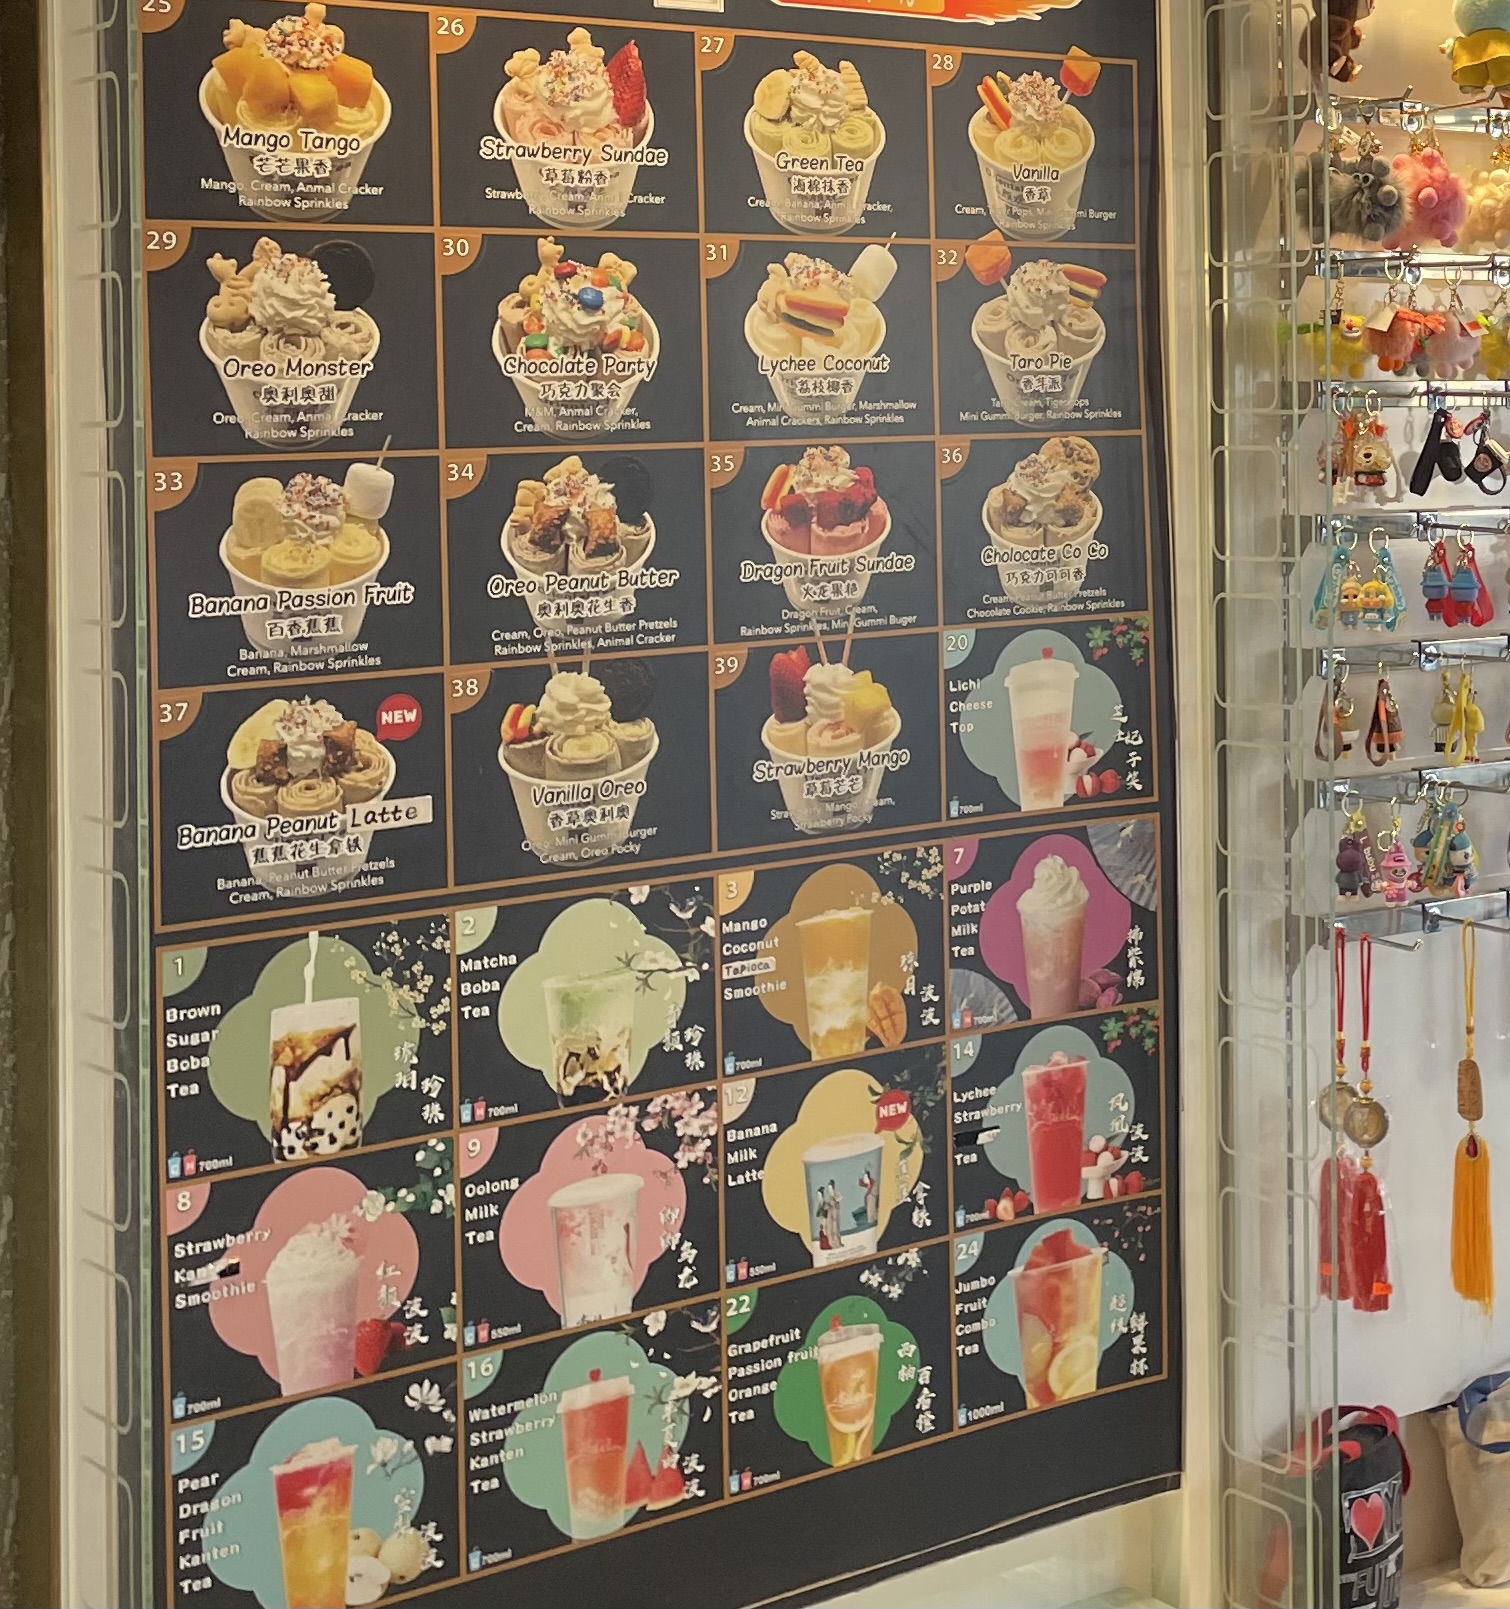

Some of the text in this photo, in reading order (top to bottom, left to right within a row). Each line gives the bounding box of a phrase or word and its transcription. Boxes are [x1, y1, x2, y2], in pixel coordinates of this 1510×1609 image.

[436, 17, 464, 36] 26
[701, 37, 724, 53] 27
[932, 54, 954, 71] 28
[223, 127, 361, 155] Mango Tango
[480, 137, 668, 166] Strawberry Sundae
[776, 152, 864, 172] Green Tea
[1013, 164, 1060, 181] Vanilla
[293, 197, 349, 210] Sprinkles
[146, 231, 177, 250] 29
[442, 238, 469, 257] 30
[706, 244, 727, 261] 31
[936, 250, 958, 265] 32
[223, 358, 372, 379] Oreo Monster
[503, 356, 656, 380] Chocolate Party
[760, 354, 890, 377] Lychee Coconut
[1009, 353, 1072, 370] Taro Pie
[300, 427, 354, 438] Sprinkles
[555, 419, 651, 432] Rainbow Sprinkles
[711, 455, 735, 472] 35
[941, 448, 963, 464] 36
[447, 463, 474, 481] 34
[154, 472, 183, 492] 33
[1062, 543, 1082, 559] Co
[1088, 541, 1108, 558] Co
[741, 552, 915, 583] Dragon Fruit Sundae
[488, 569, 679, 597] Oreo Peanut Butter
[189, 582, 413, 616] Banana Passion Fruit
[947, 635, 968, 651] 20
[227, 655, 381, 678] Cream, Rainbow Sprinkles
[714, 657, 739, 675] 39
[451, 678, 479, 697] 38
[949, 678, 981, 692] Lichi
[159, 703, 188, 723] 37
[950, 699, 993, 713] Cheese
[380, 709, 418, 725] NEW
[950, 722, 974, 734] Top
[754, 749, 909, 782] Strawberry Mango
[531, 779, 647, 807] Vanilla Oreo
[177, 805, 418, 848] Banana Peanut Latte
[953, 848, 964, 864] 7
[726, 881, 738, 898] 3
[951, 880, 992, 896] Purple
[461, 916, 476, 935] 2
[722, 918, 768, 934] Mango
[951, 923, 978, 938] Milk
[722, 937, 779, 956] Coconut
[951, 945, 975, 958] Tea
[173, 957, 183, 977] 1
[460, 953, 518, 973] Matcha
[460, 978, 500, 996] Boba
[724, 980, 787, 1000] Smoothie
[166, 1002, 221, 1023] Brown
[460, 1005, 490, 1020] Tea
[166, 1028, 220, 1049] Sugar
[953, 1042, 974, 1060] 14
[166, 1055, 211, 1074] Boba
[167, 1082, 200, 1099] Tea
[725, 1085, 748, 1106] 12
[953, 1086, 997, 1104] Lychee
[879, 1101, 908, 1118] NEW
[953, 1101, 1022, 1124] Strawberry
[726, 1122, 778, 1142] Banana
[467, 1138, 481, 1158] 9
[727, 1147, 758, 1165] Milk
[955, 1152, 978, 1167] Tea
[728, 1169, 764, 1187] Latte
[177, 1191, 191, 1212] 8
[464, 1203, 500, 1222] Milk
[174, 1228, 271, 1259] Strawberry
[464, 1229, 495, 1246] Tea
[957, 1240, 978, 1261] 24
[175, 1280, 257, 1310] Smoothie
[954, 1276, 996, 1295] Jumbo
[726, 1295, 751, 1317] 22
[955, 1296, 988, 1316] Fruit
[955, 1317, 997, 1337] Combo
[728, 1327, 801, 1358] Grapefruit
[956, 1343, 979, 1358] Tea
[467, 1358, 494, 1380] 16
[728, 1345, 819, 1380] Passion fruit
[728, 1380, 778, 1402] Orange
[468, 1391, 558, 1423] Watermelon
[728, 1408, 755, 1424] Tea
[469, 1415, 556, 1447] Strawberry
[176, 1429, 204, 1455] 15
[469, 1447, 525, 1472] Kanten
[178, 1471, 220, 1494] Pear
[469, 1477, 500, 1494] Tea
[178, 1491, 242, 1520] Dragon
[178, 1520, 224, 1545] Fruit
[179, 1543, 241, 1571] Kanten
[179, 1575, 213, 1595] Tea
